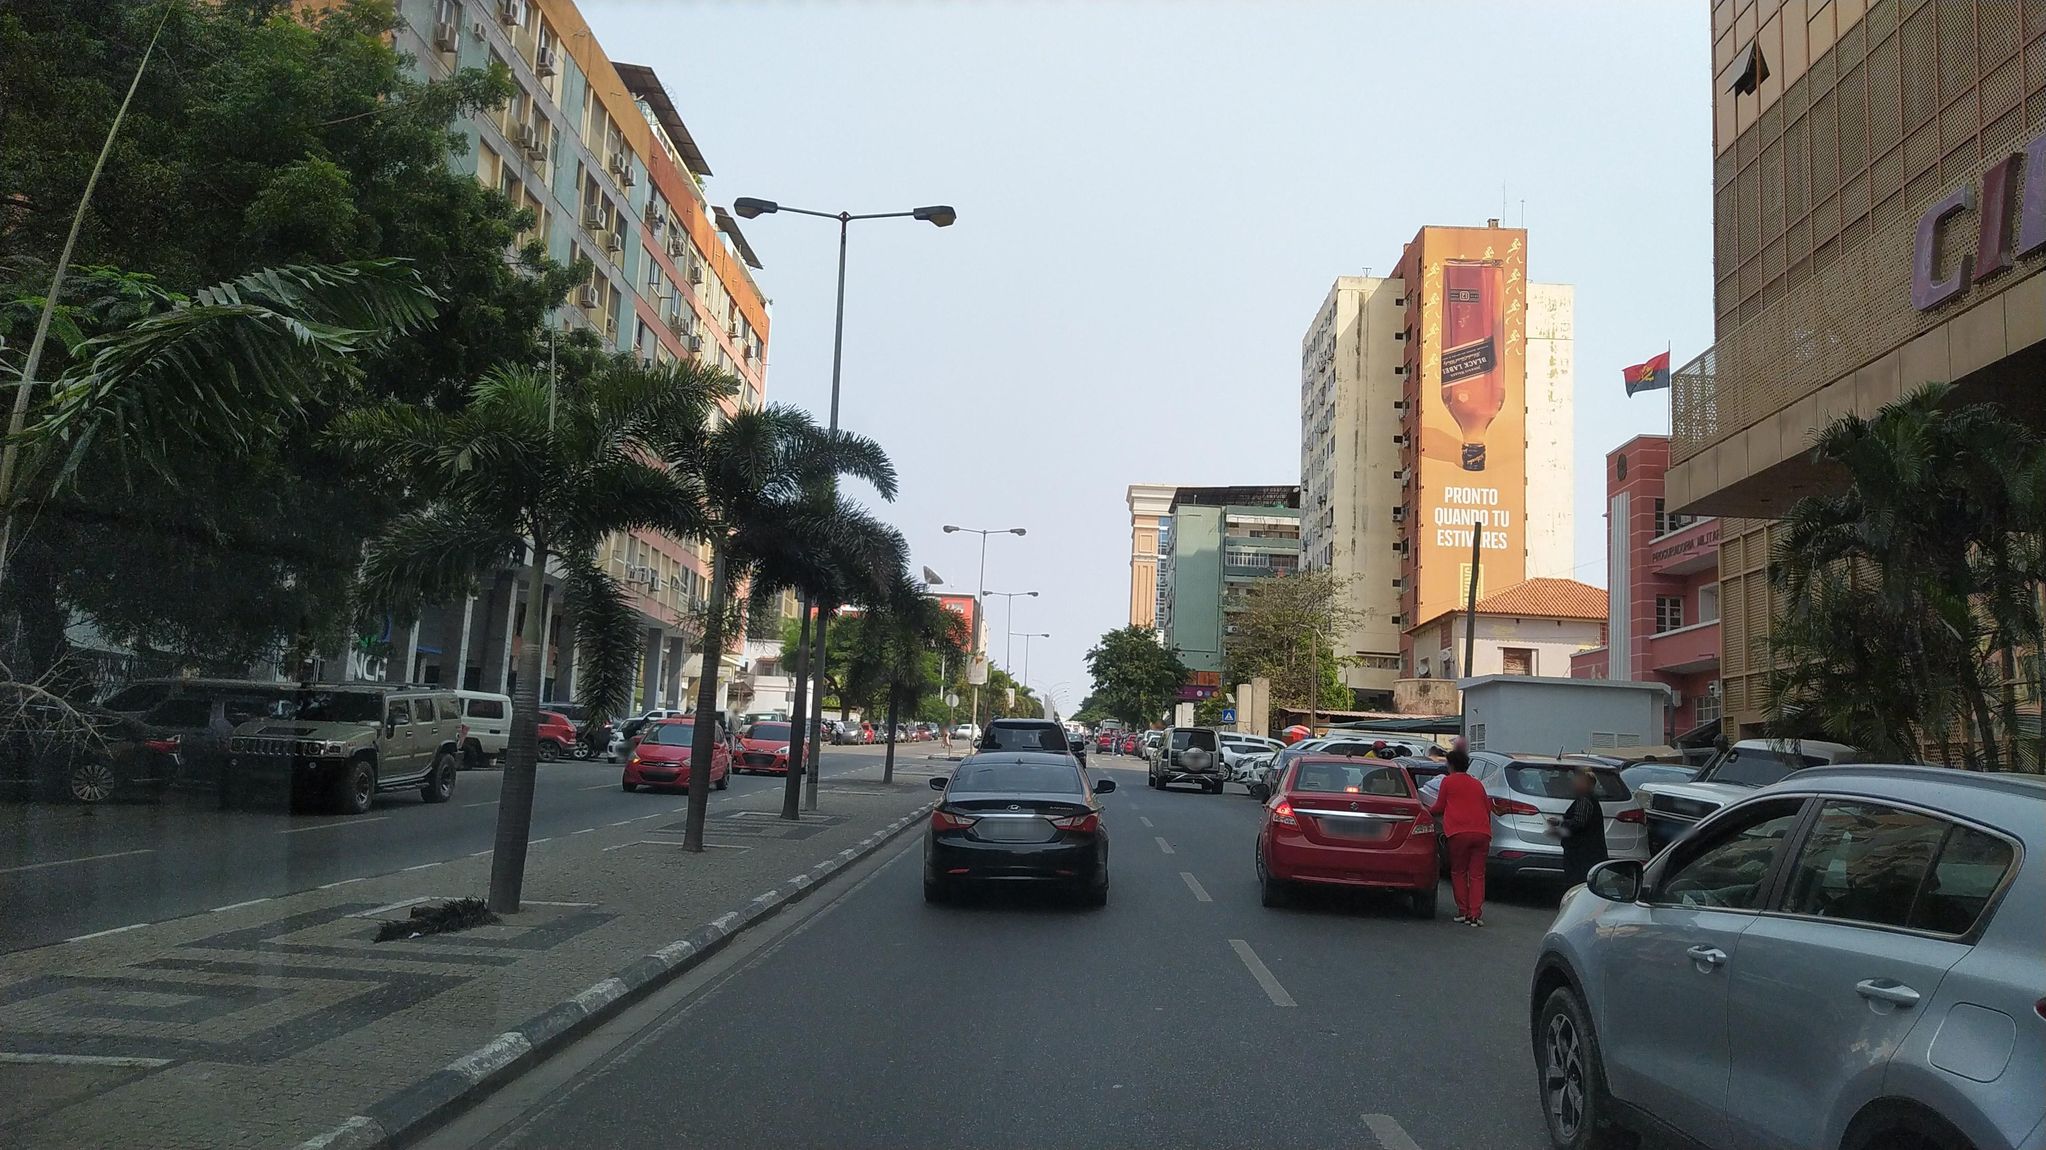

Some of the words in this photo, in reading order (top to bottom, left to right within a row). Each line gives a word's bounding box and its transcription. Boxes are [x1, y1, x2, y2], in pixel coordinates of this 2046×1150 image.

[1464, 356, 1487, 369] BLACK
[1444, 486, 1498, 505] PRONTO
[1434, 507, 1489, 527] QUANDO
[1491, 510, 1510, 527] TU
[1437, 529, 1508, 549] ESTIVRES
